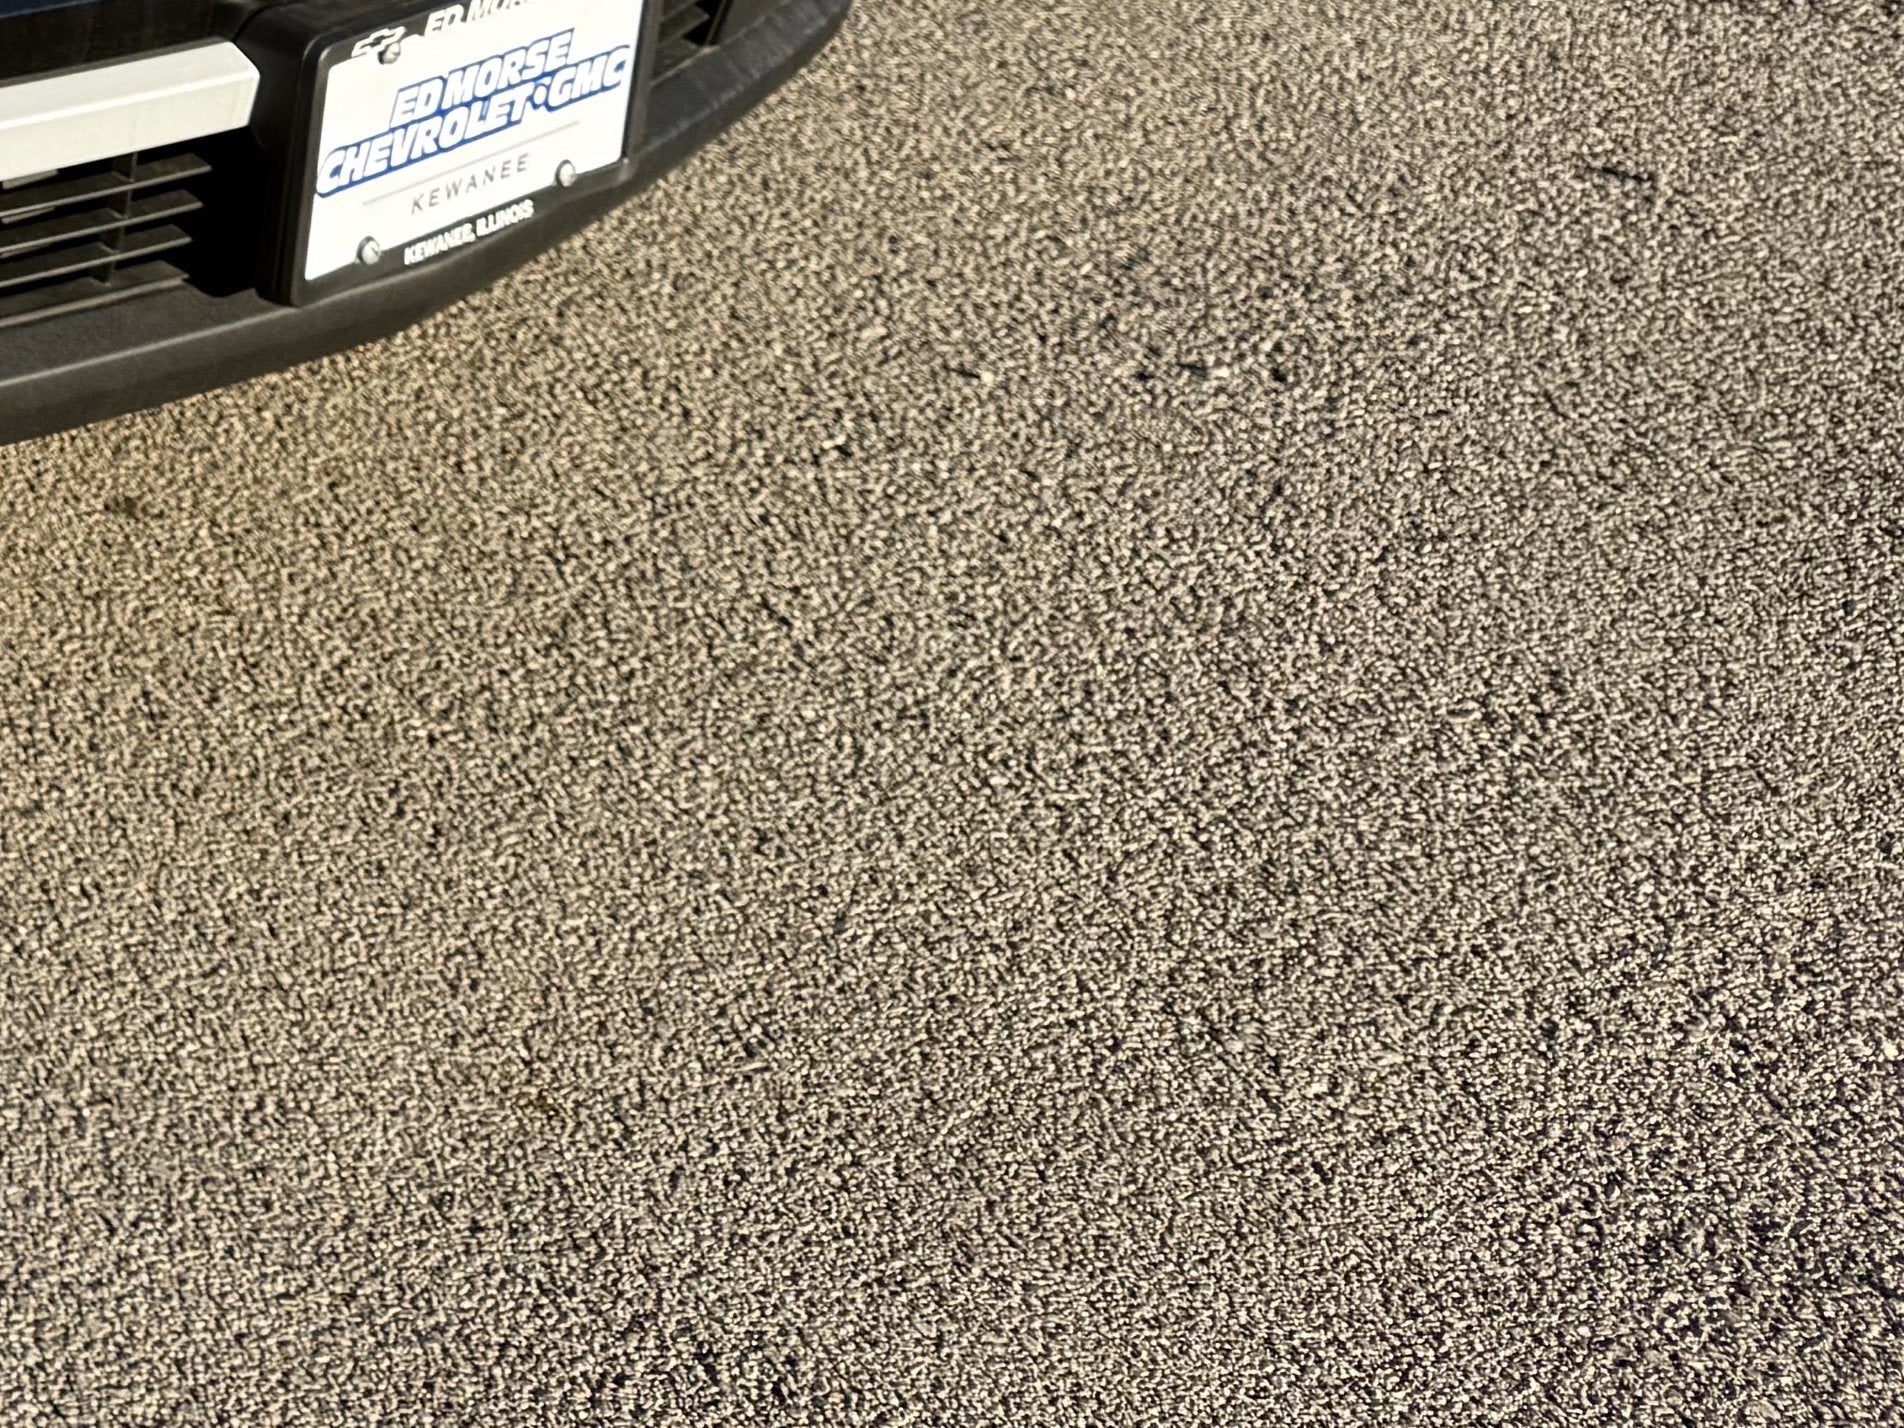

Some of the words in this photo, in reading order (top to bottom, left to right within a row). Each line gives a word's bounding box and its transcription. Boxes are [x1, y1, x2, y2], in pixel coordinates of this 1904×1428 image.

[423, 3, 465, 37] ED
[389, 75, 448, 131] ED
[441, 28, 575, 110] MORSE
[410, 152, 530, 215] KEWANEE
[475, 198, 535, 237] ILLINOIS
